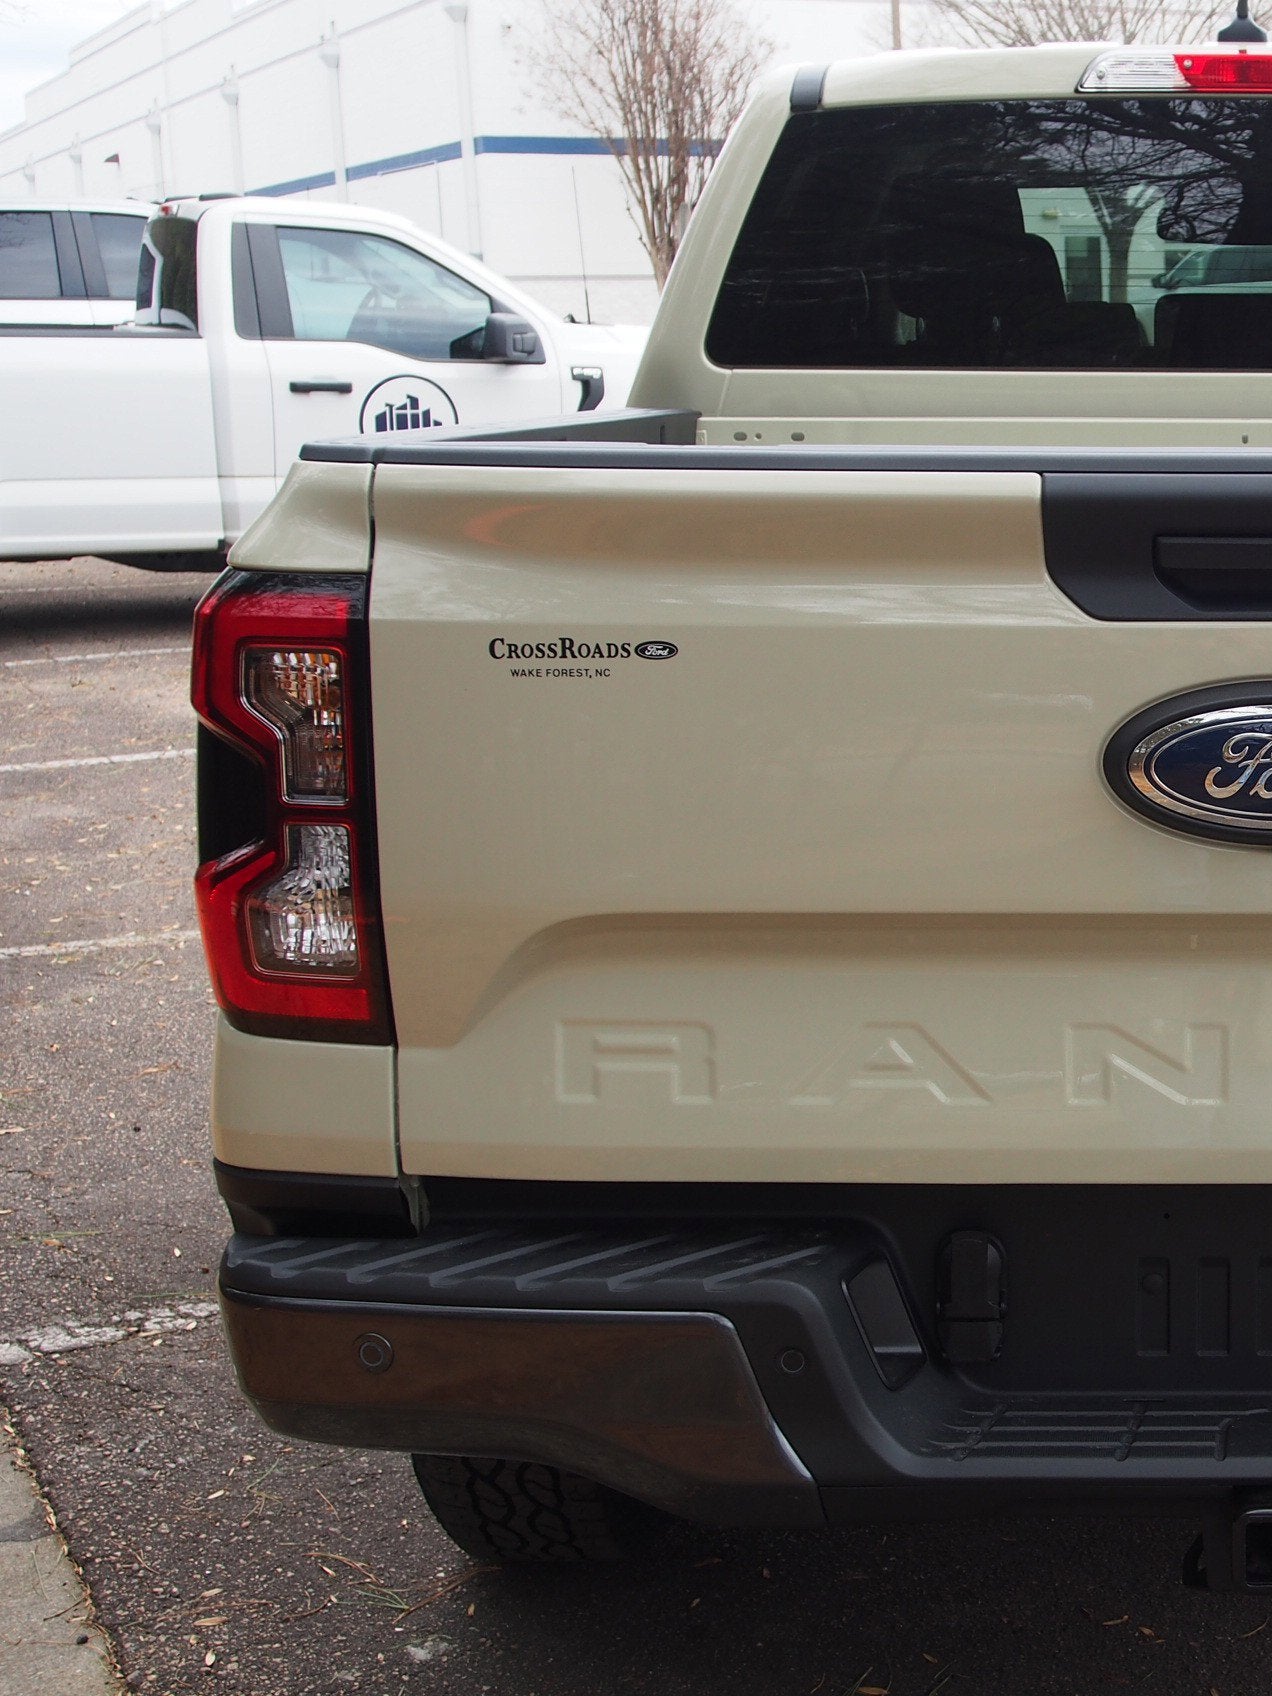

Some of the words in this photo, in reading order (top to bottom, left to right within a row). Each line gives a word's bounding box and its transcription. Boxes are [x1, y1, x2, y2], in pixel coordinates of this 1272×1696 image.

[510, 668, 542, 678] WAKE
[546, 668, 593, 679] FOREST,
[595, 668, 611, 678] NC
